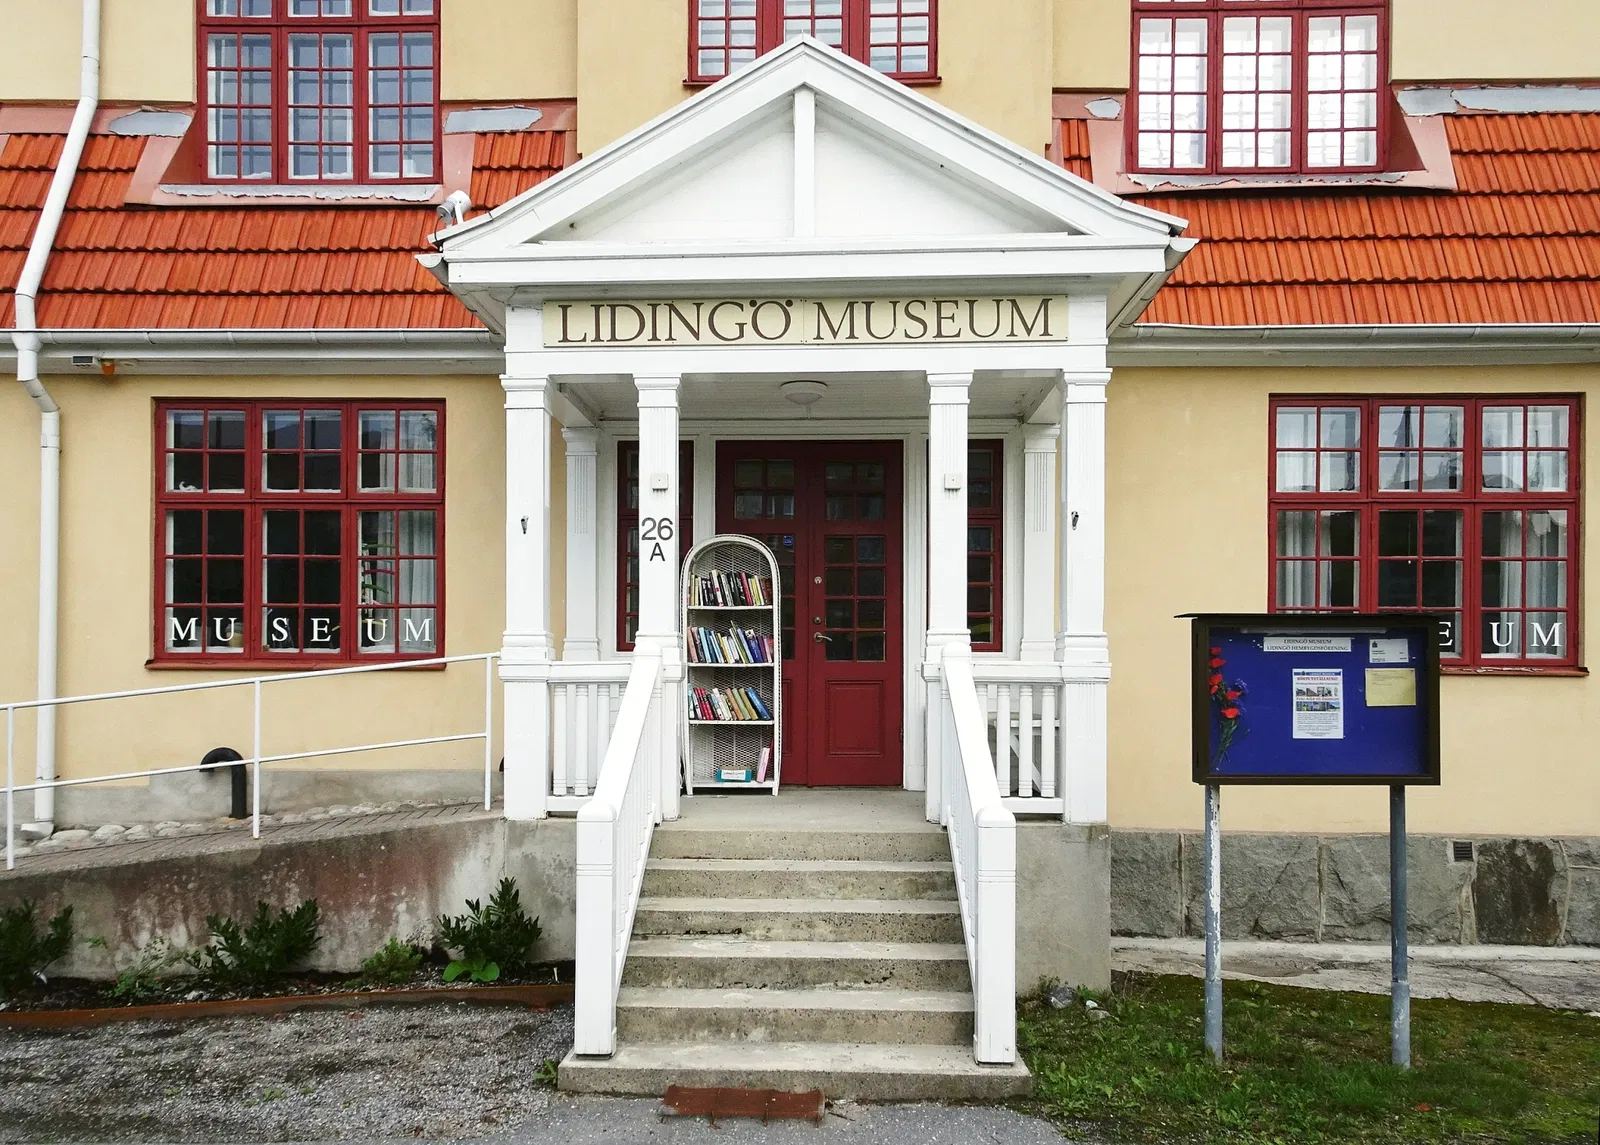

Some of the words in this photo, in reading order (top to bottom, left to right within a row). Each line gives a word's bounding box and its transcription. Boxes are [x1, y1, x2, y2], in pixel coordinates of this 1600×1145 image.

[557, 299, 794, 344] LIDINGÖ
[812, 298, 1054, 341] MUSEUM
[641, 516, 674, 541] 26
[649, 542, 666, 562] A
[169, 616, 433, 643] MUSEUM
